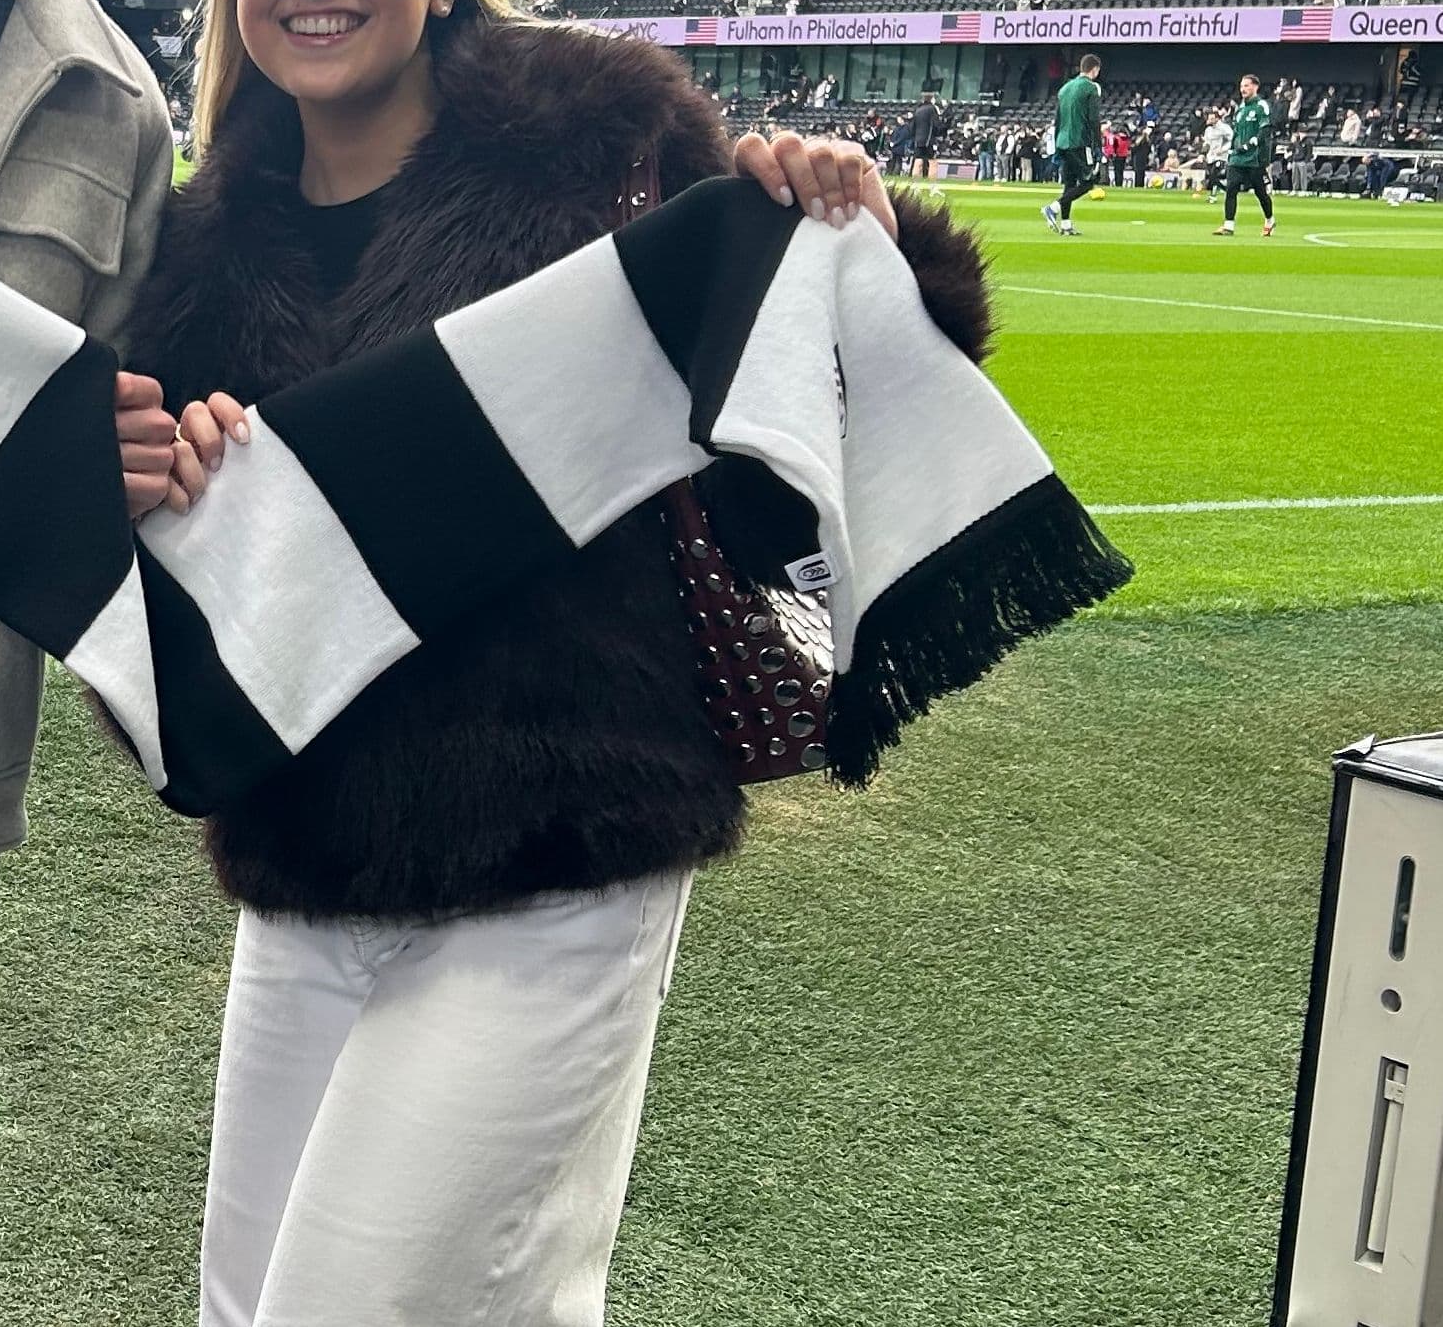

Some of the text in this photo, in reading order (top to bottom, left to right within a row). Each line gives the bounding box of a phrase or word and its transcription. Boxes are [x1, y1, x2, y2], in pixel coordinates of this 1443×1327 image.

[727, 18, 907, 44] Fulham In Philadelphia
[993, 12, 1240, 39] Portland Fulham Faithful
[1349, 11, 1428, 36] Queen
